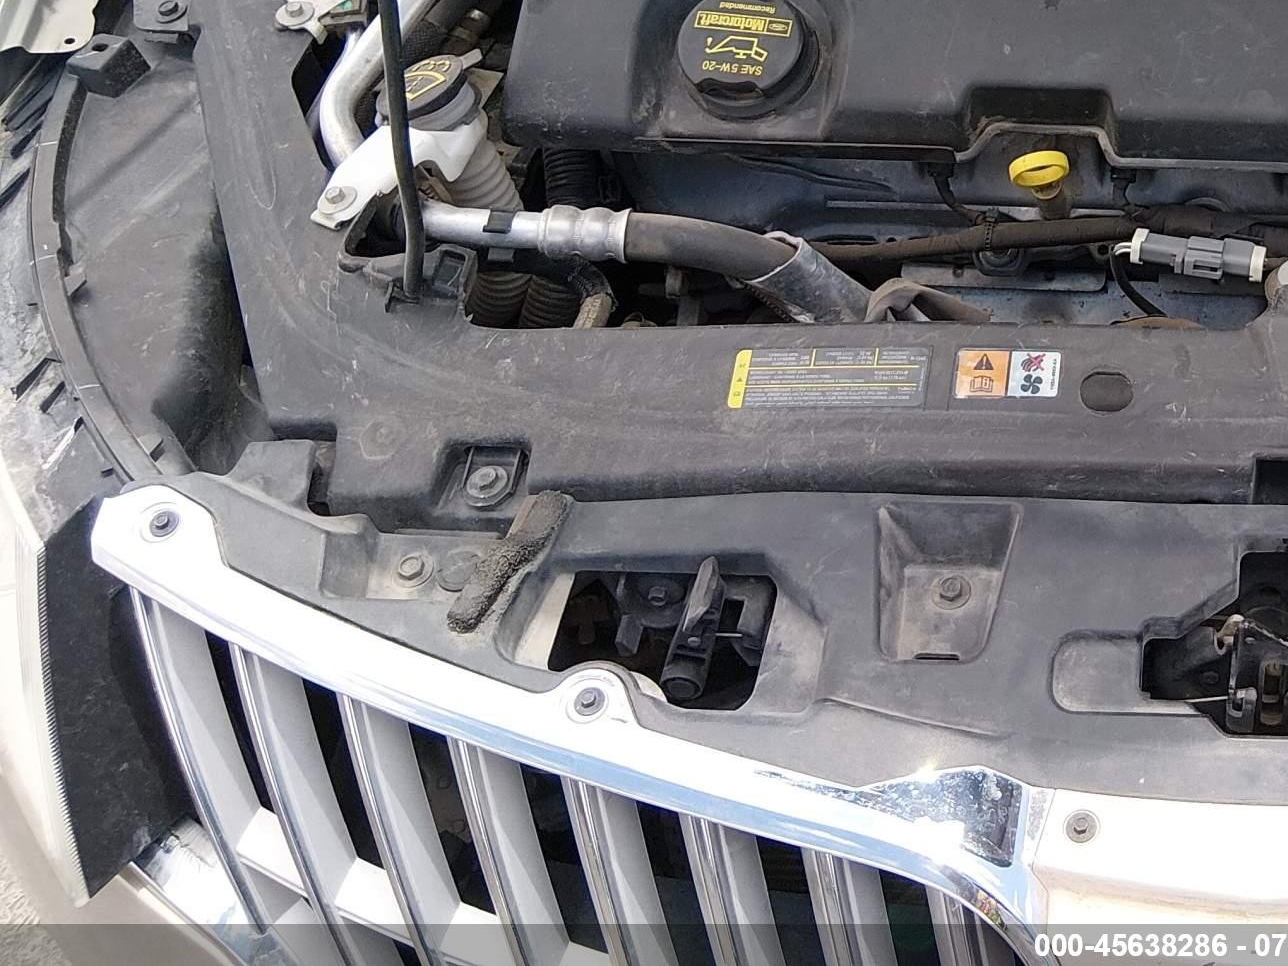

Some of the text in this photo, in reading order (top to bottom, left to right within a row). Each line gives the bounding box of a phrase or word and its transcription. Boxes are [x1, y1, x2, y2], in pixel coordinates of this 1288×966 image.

[719, 2, 776, 14] Recommended
[700, 13, 765, 31] Motorcraft
[703, 60, 763, 75] SAE 5W-20
